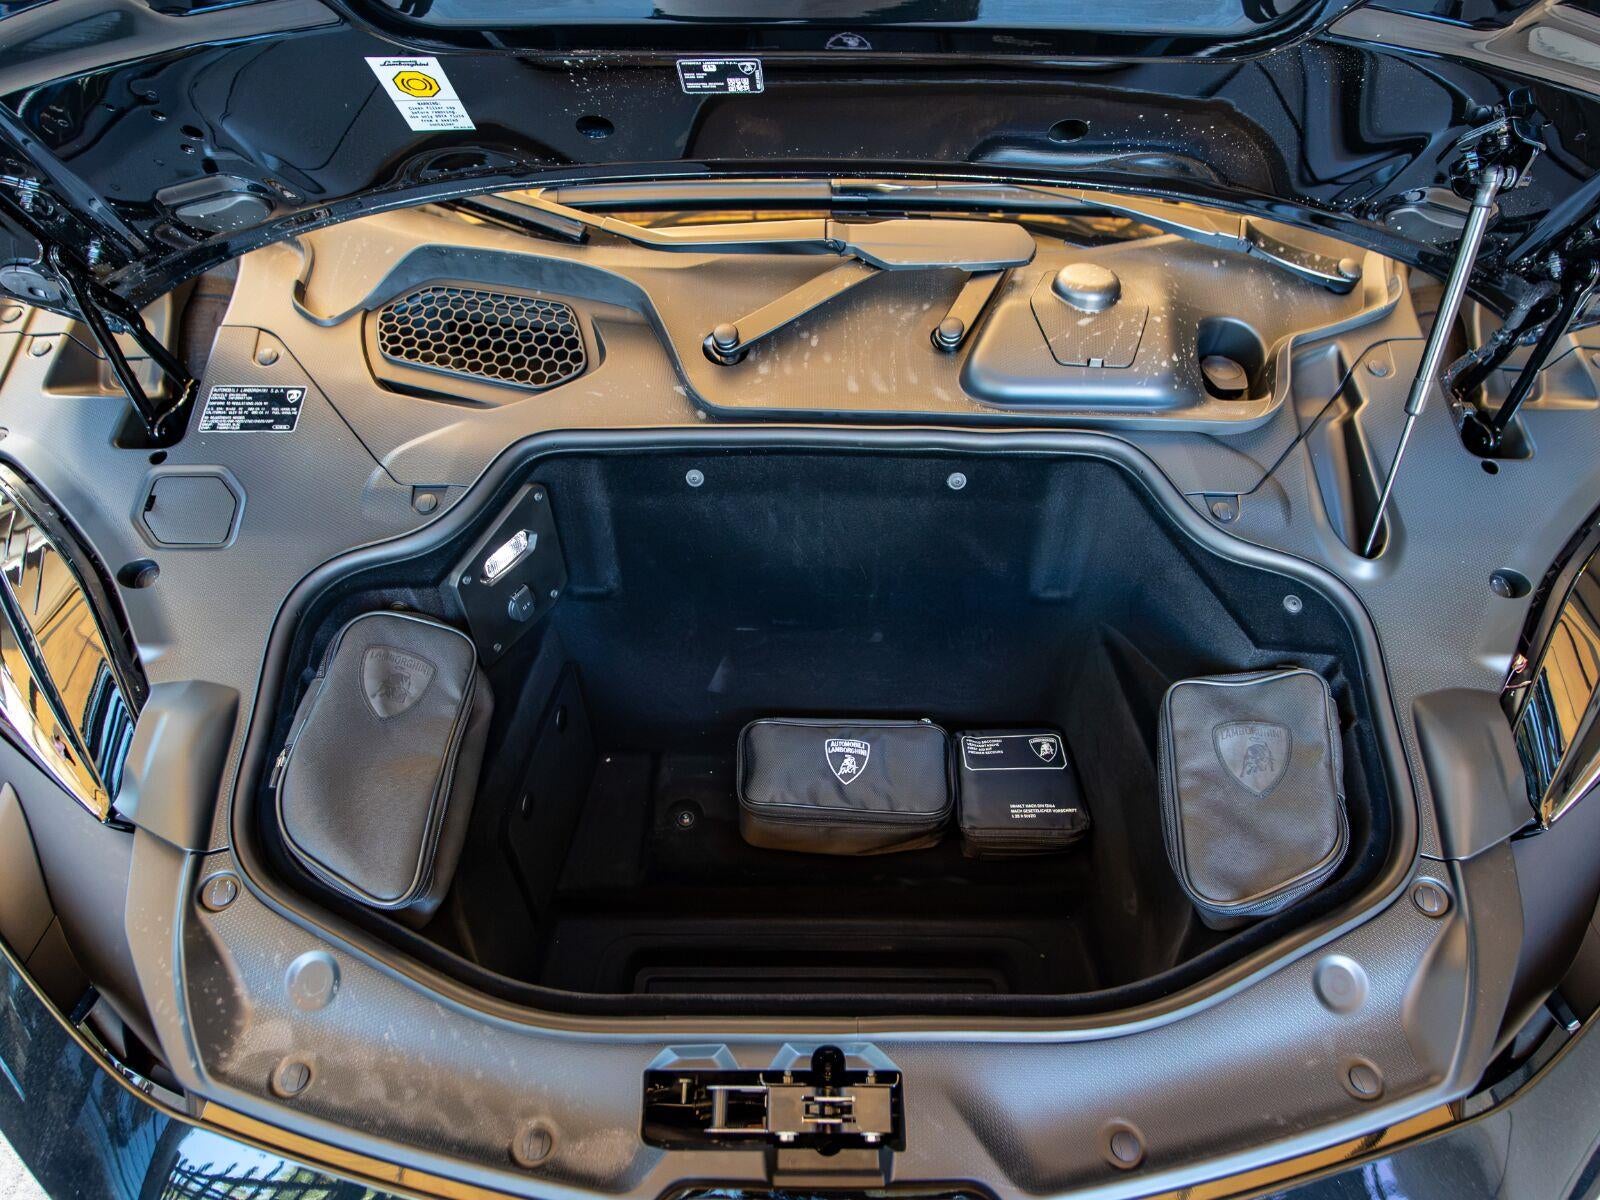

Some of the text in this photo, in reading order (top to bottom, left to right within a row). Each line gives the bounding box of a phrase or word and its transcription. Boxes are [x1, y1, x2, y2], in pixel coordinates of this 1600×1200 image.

[1220, 727, 1282, 740] LAMBORGHINI
[830, 740, 865, 749] AUTOMOBILI
[828, 747, 867, 756] LAMBORGHINI
